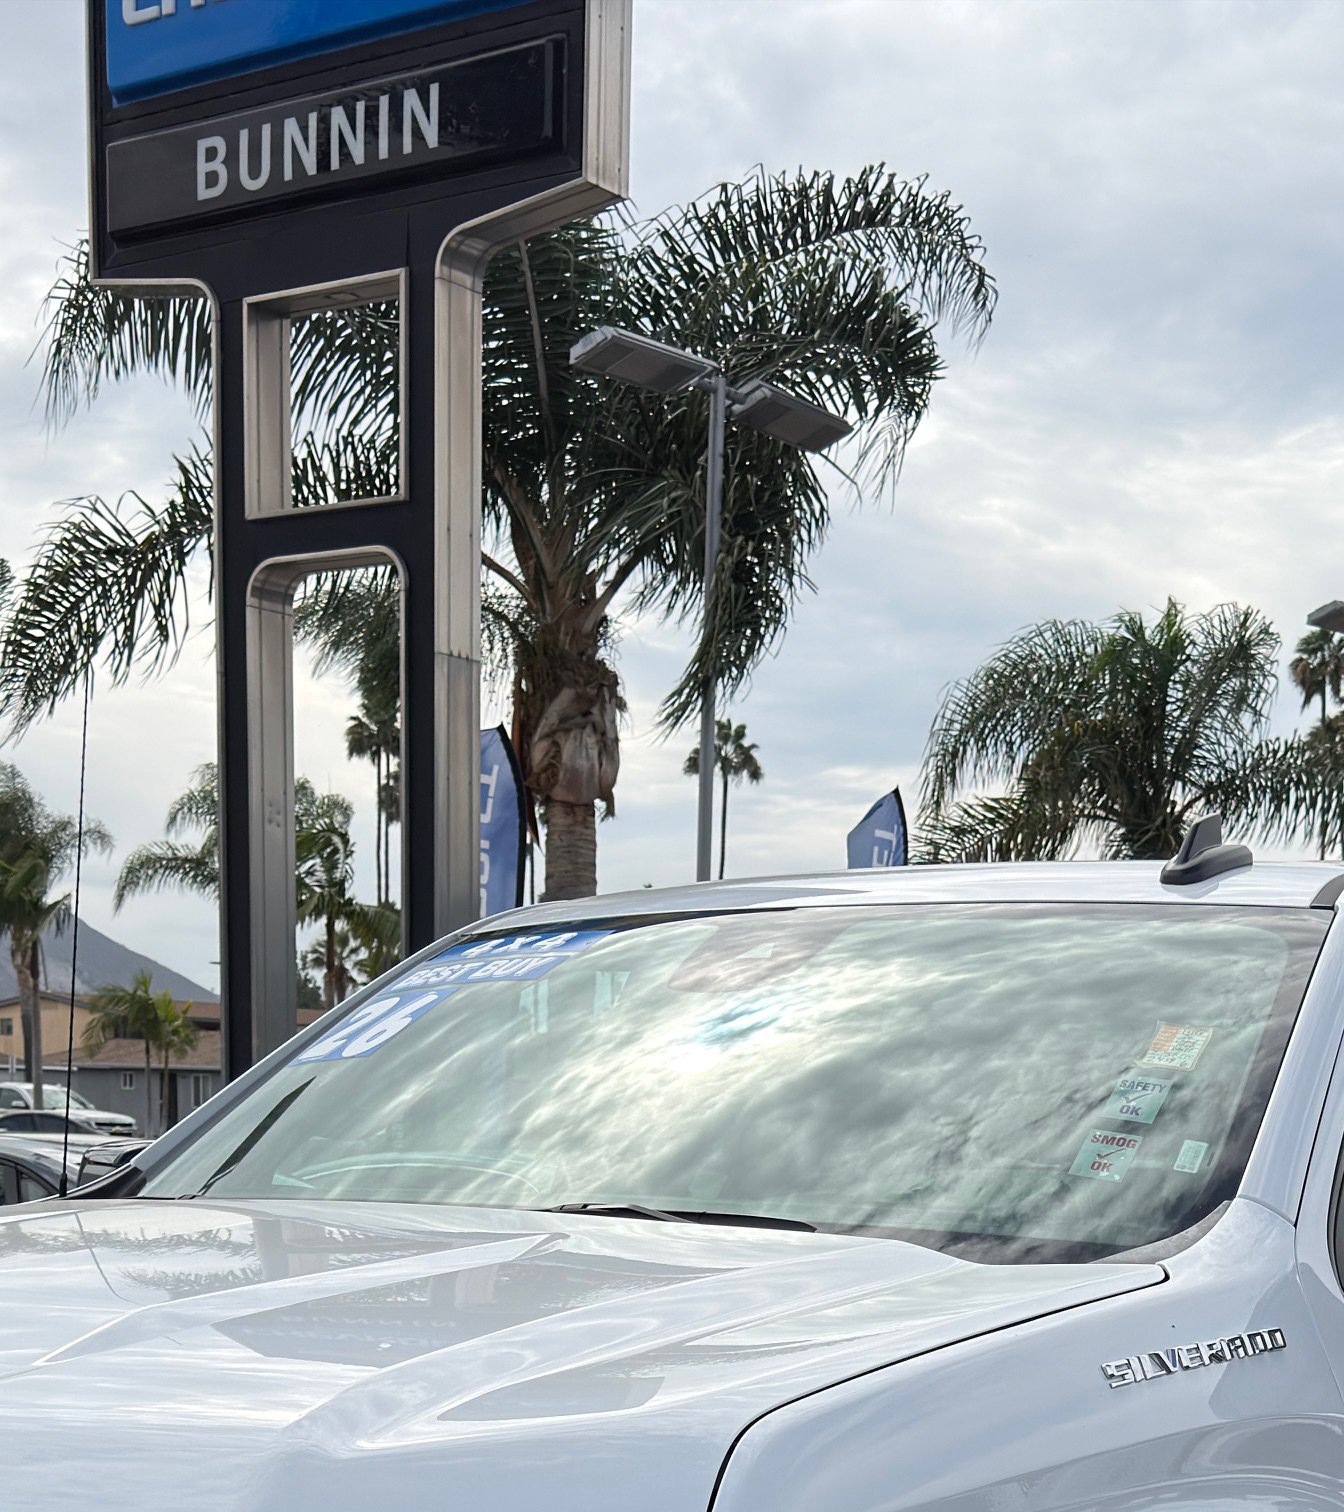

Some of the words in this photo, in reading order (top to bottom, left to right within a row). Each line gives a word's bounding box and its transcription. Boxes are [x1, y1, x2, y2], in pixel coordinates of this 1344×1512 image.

[197, 82, 440, 201] BUNNIN
[391, 961, 486, 991] BEST
[468, 956, 558, 980] BUY
[297, 991, 439, 1060] 26
[1119, 1079, 1167, 1094] SAFETY
[1119, 1104, 1143, 1117] OK
[1090, 1133, 1138, 1150] SMOG
[1090, 1161, 1114, 1173] OK
[1101, 1327, 1288, 1389] SILVERADO
